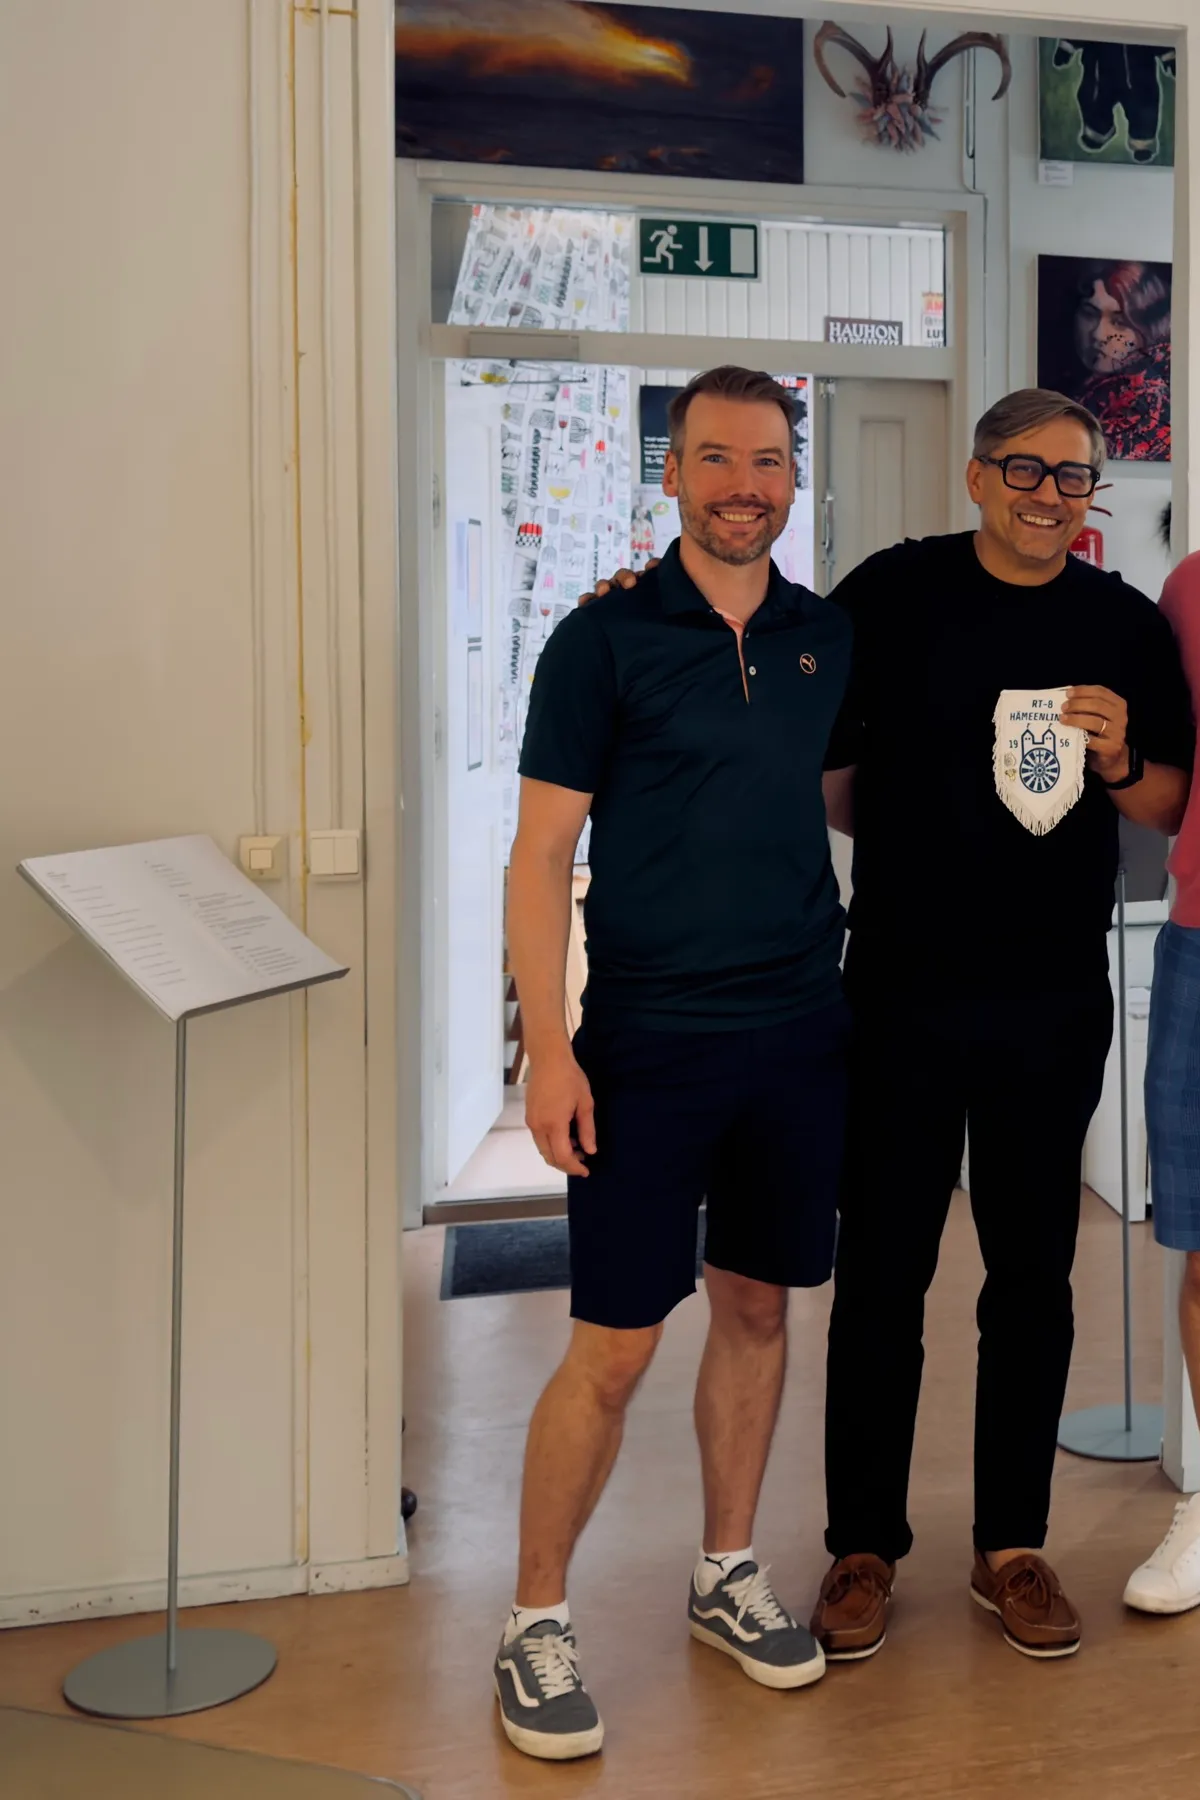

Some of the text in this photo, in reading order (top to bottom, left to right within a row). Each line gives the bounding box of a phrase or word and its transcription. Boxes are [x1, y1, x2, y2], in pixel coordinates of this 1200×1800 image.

[828, 321, 900, 340] HAUHON
[1032, 699, 1053, 708] RT-8
[1010, 710, 1060, 721] HÄMEENLIN
[1009, 738, 1070, 748] 19 56
